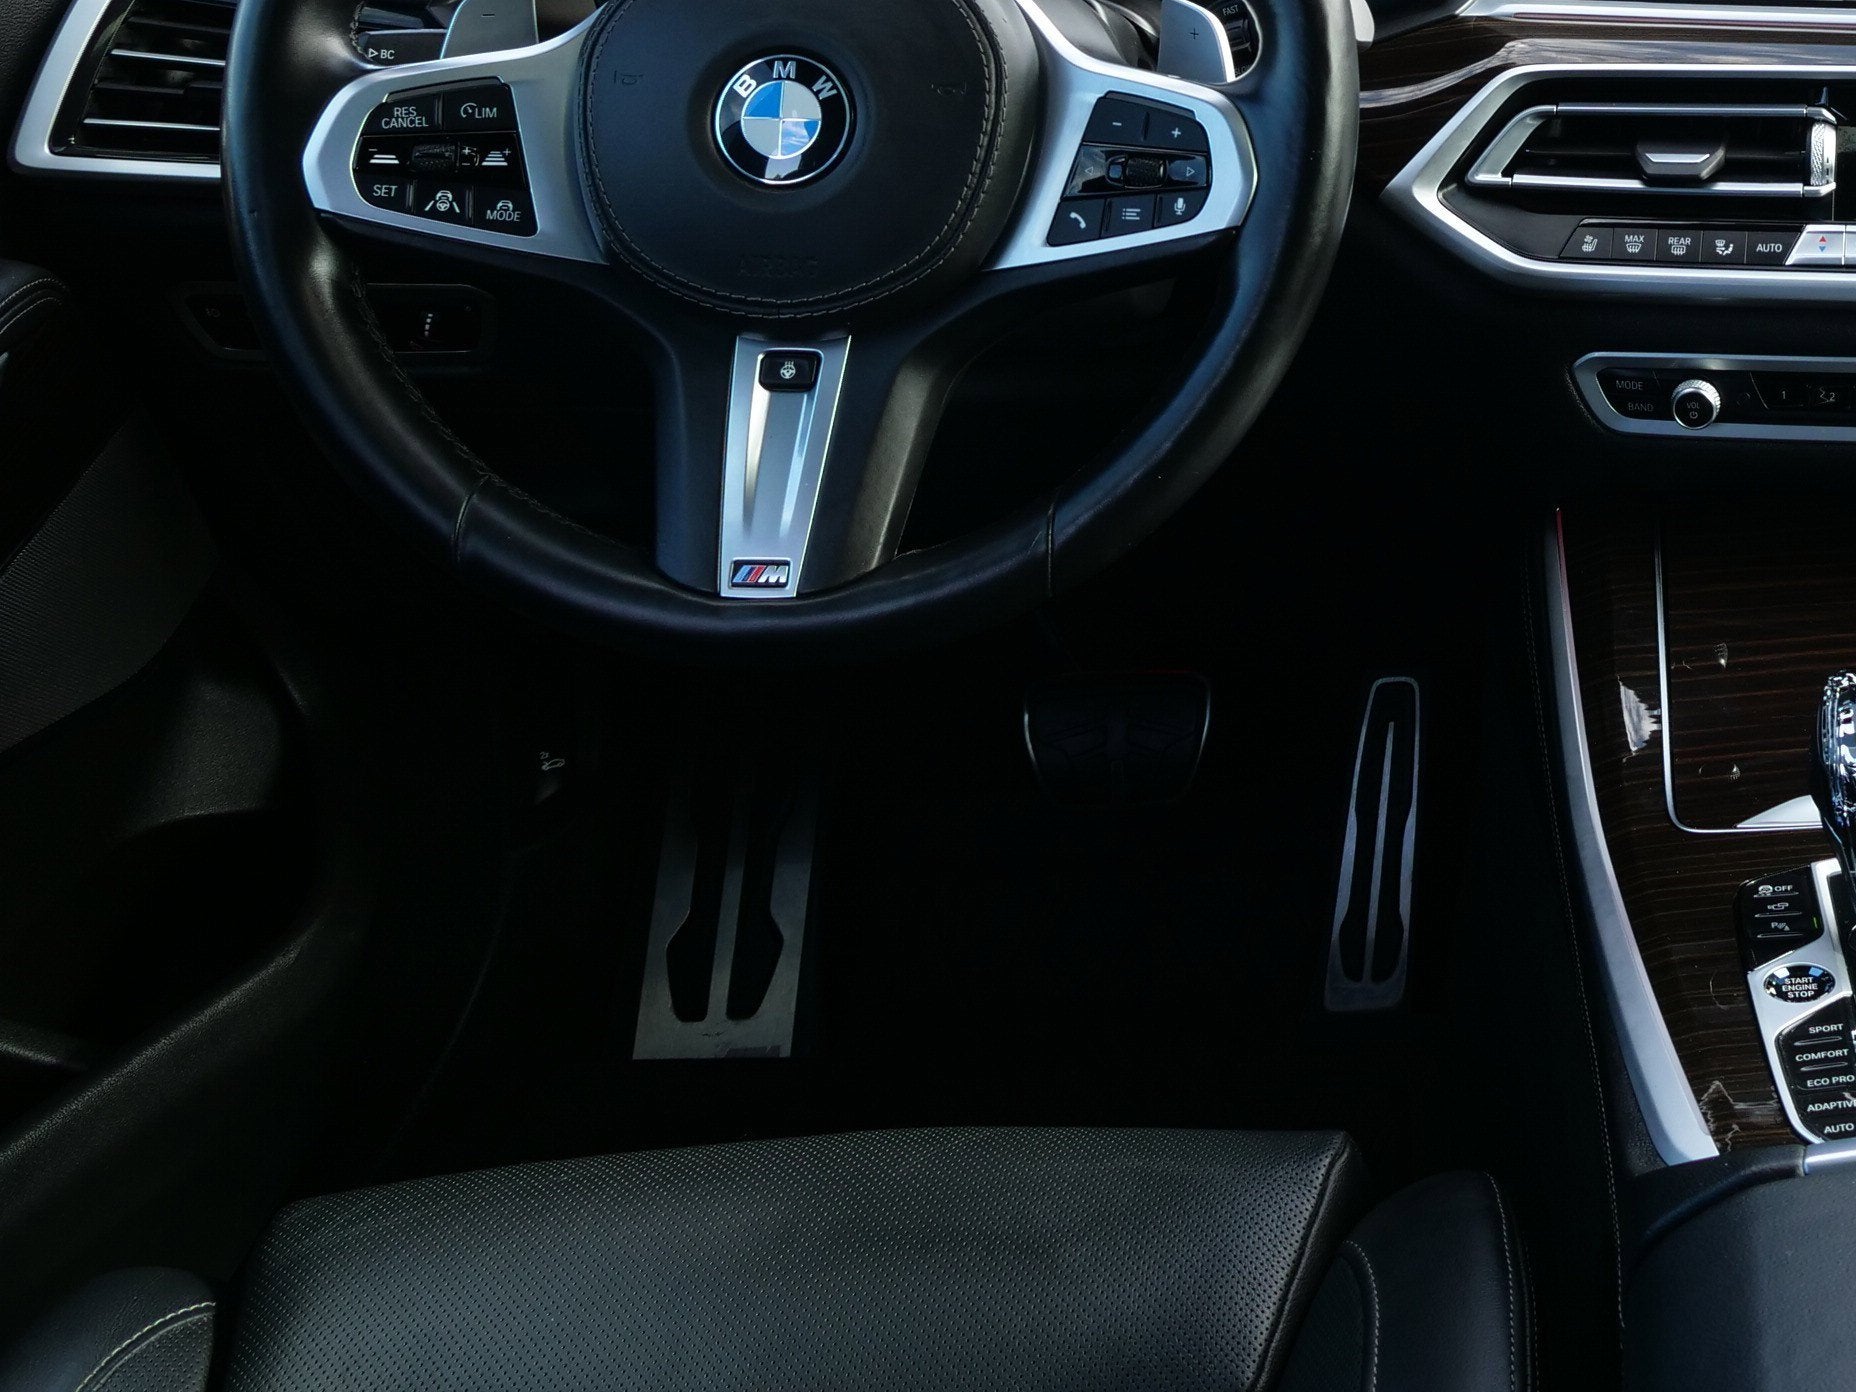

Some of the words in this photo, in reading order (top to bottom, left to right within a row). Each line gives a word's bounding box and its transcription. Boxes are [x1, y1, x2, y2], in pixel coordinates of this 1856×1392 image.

[1222, 4, 1239, 17] FAST
[380, 50, 395, 59] BC
[732, 60, 838, 100] BMW
[394, 107, 417, 117] RES
[475, 107, 497, 119] LIM
[381, 116, 429, 129] CANCEL
[373, 185, 398, 197] SET
[485, 210, 521, 221] MODE
[1625, 235, 1644, 243] MAX
[1668, 237, 1691, 246] REAR
[1756, 243, 1782, 253] AUTO
[1616, 380, 1643, 391] MODE
[1781, 390, 1786, 400] 1
[1628, 402, 1655, 412] BAND
[1809, 1023, 1844, 1034] SPORT
[1795, 1048, 1849, 1062] COMFORT
[1807, 1078, 1830, 1087] ECO
[1832, 1074, 1855, 1084] PRO
[1824, 1122, 1854, 1134] AUTO
